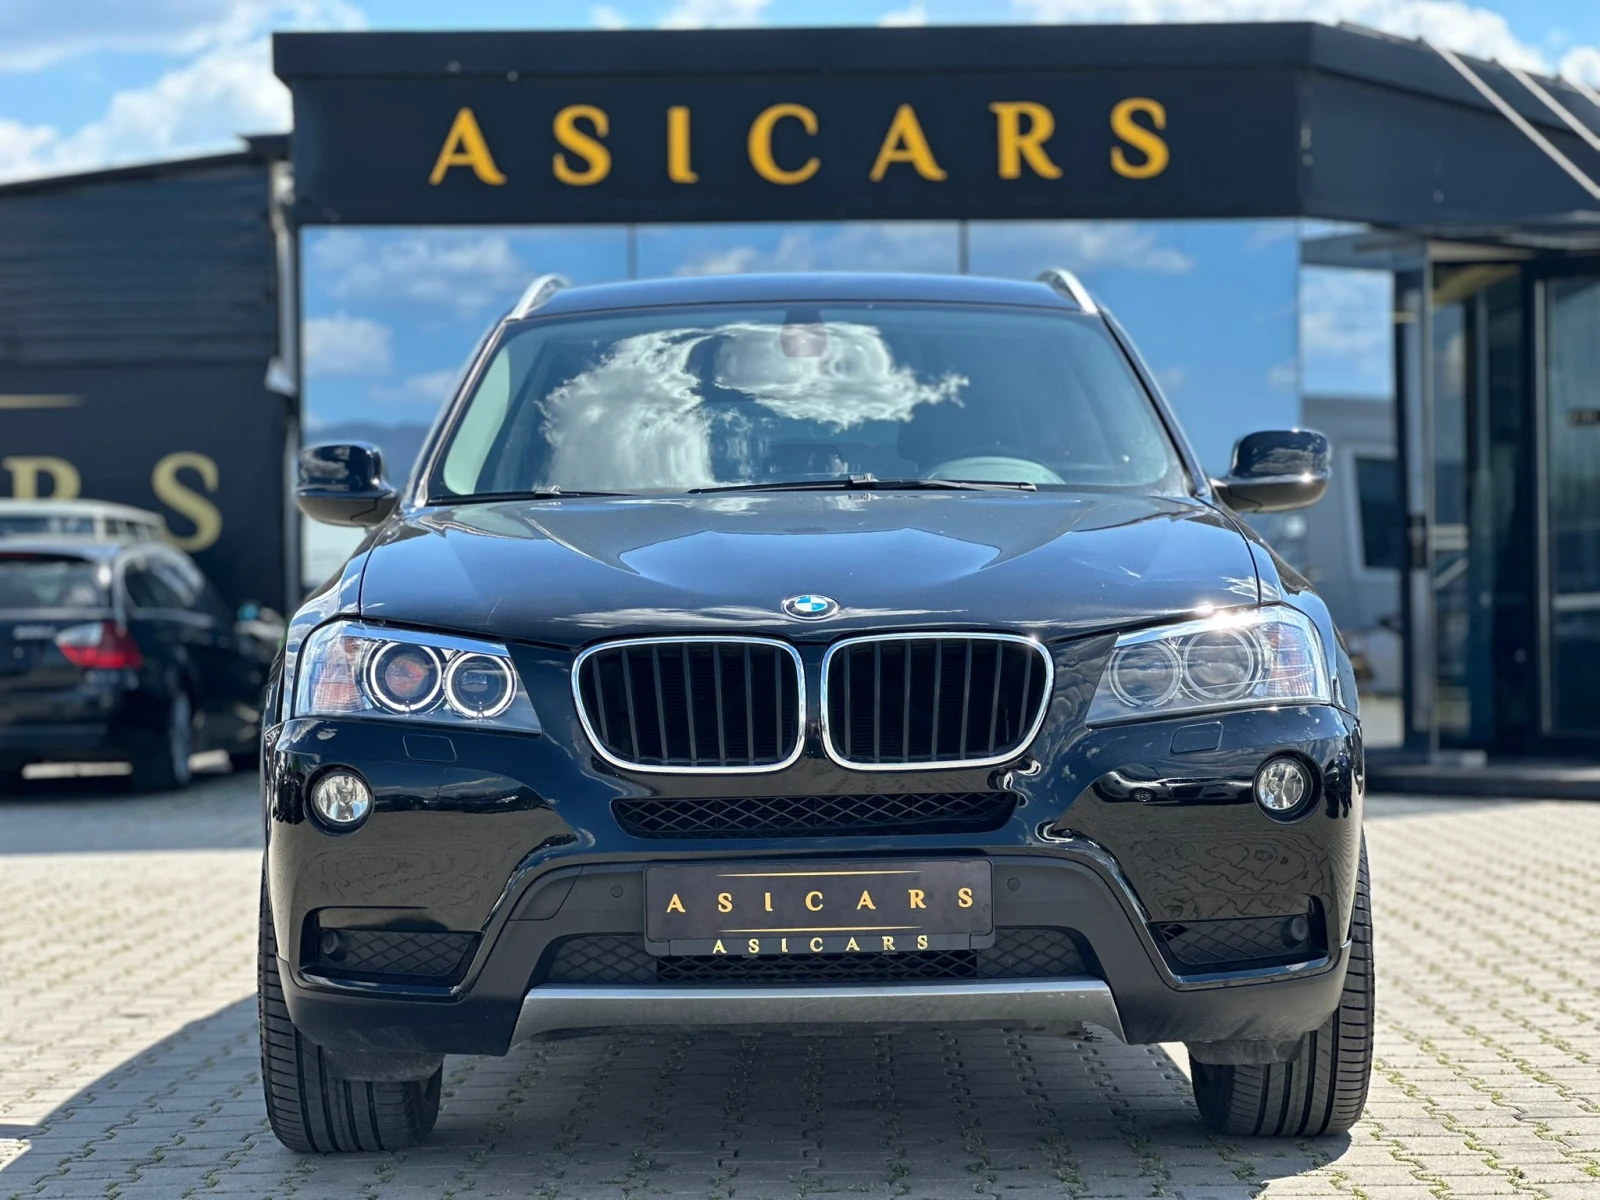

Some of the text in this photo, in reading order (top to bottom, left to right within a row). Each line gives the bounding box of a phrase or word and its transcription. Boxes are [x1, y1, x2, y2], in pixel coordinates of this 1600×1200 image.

[428, 97, 1170, 187] ASICARS
[666, 886, 974, 914] ASICARS
[712, 934, 929, 954] ASICARS
